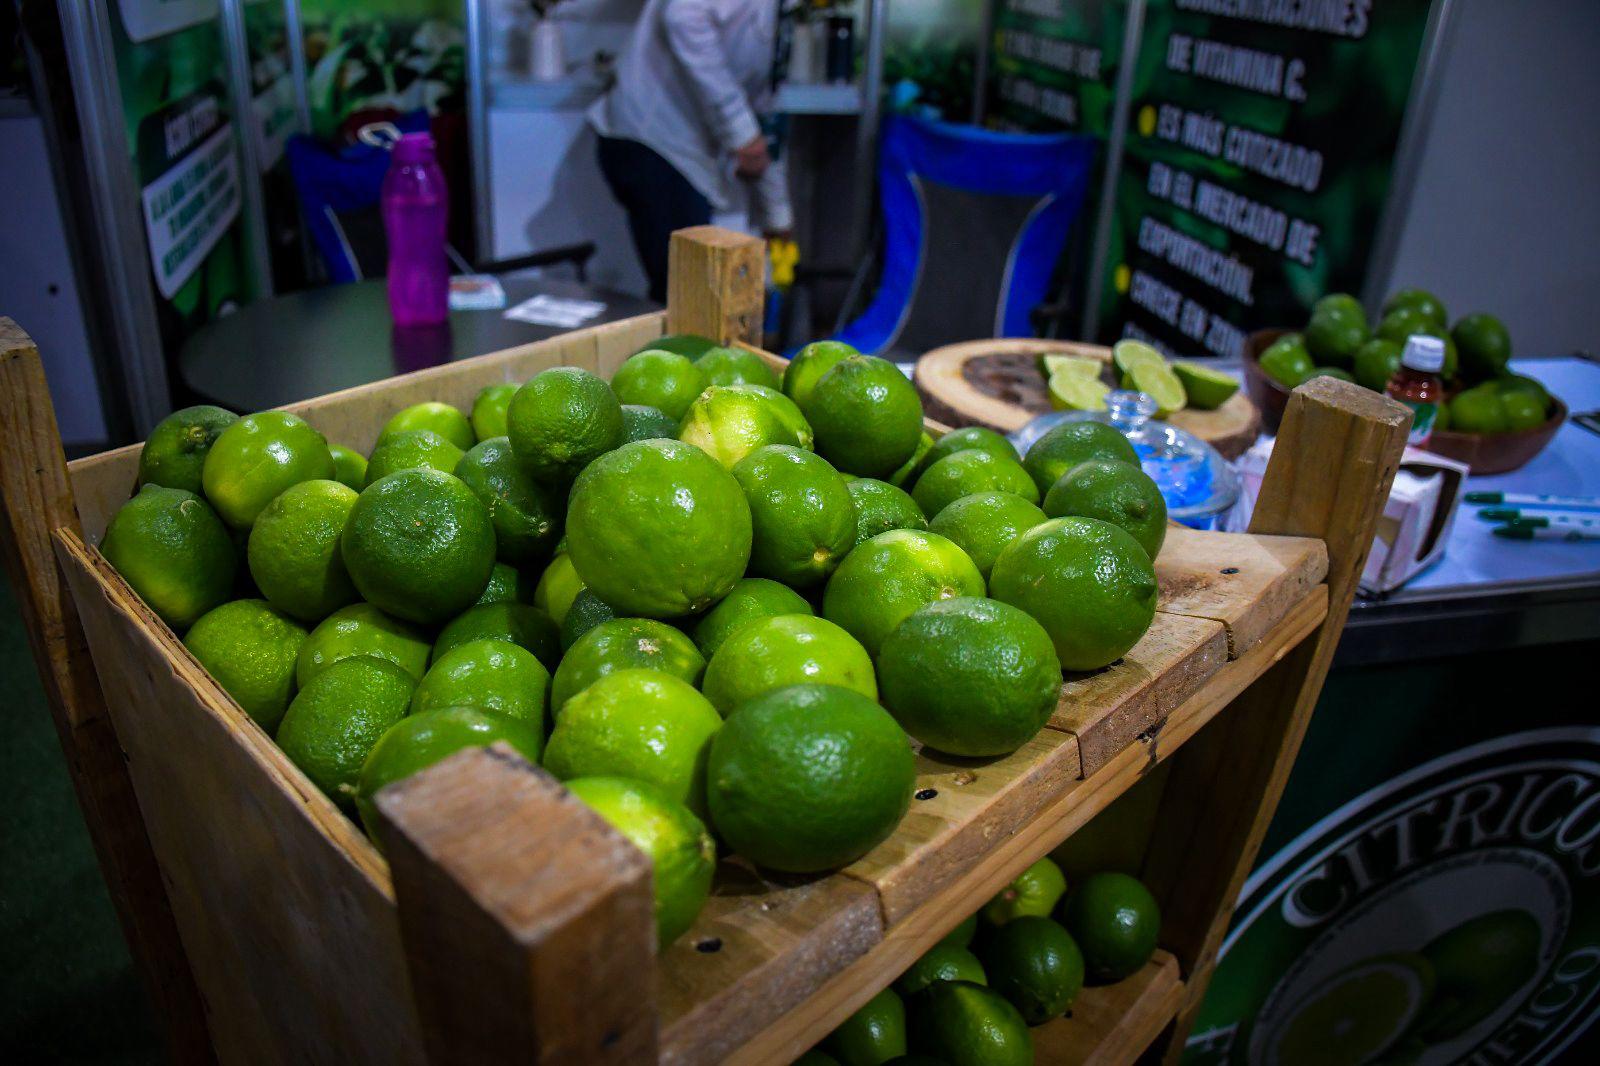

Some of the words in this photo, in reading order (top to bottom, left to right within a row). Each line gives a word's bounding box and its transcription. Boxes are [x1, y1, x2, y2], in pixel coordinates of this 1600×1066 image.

[1166, 32, 1193, 73] DE
[1192, 38, 1286, 97] VITAMINA
[1156, 101, 1184, 143] ES
[1180, 109, 1226, 157] MÁS
[1223, 125, 1325, 194] COTIZADO
[1146, 160, 1173, 200] EN
[1170, 169, 1195, 210] EL
[1193, 179, 1289, 252] MERCADO
[1284, 218, 1322, 266] DE
